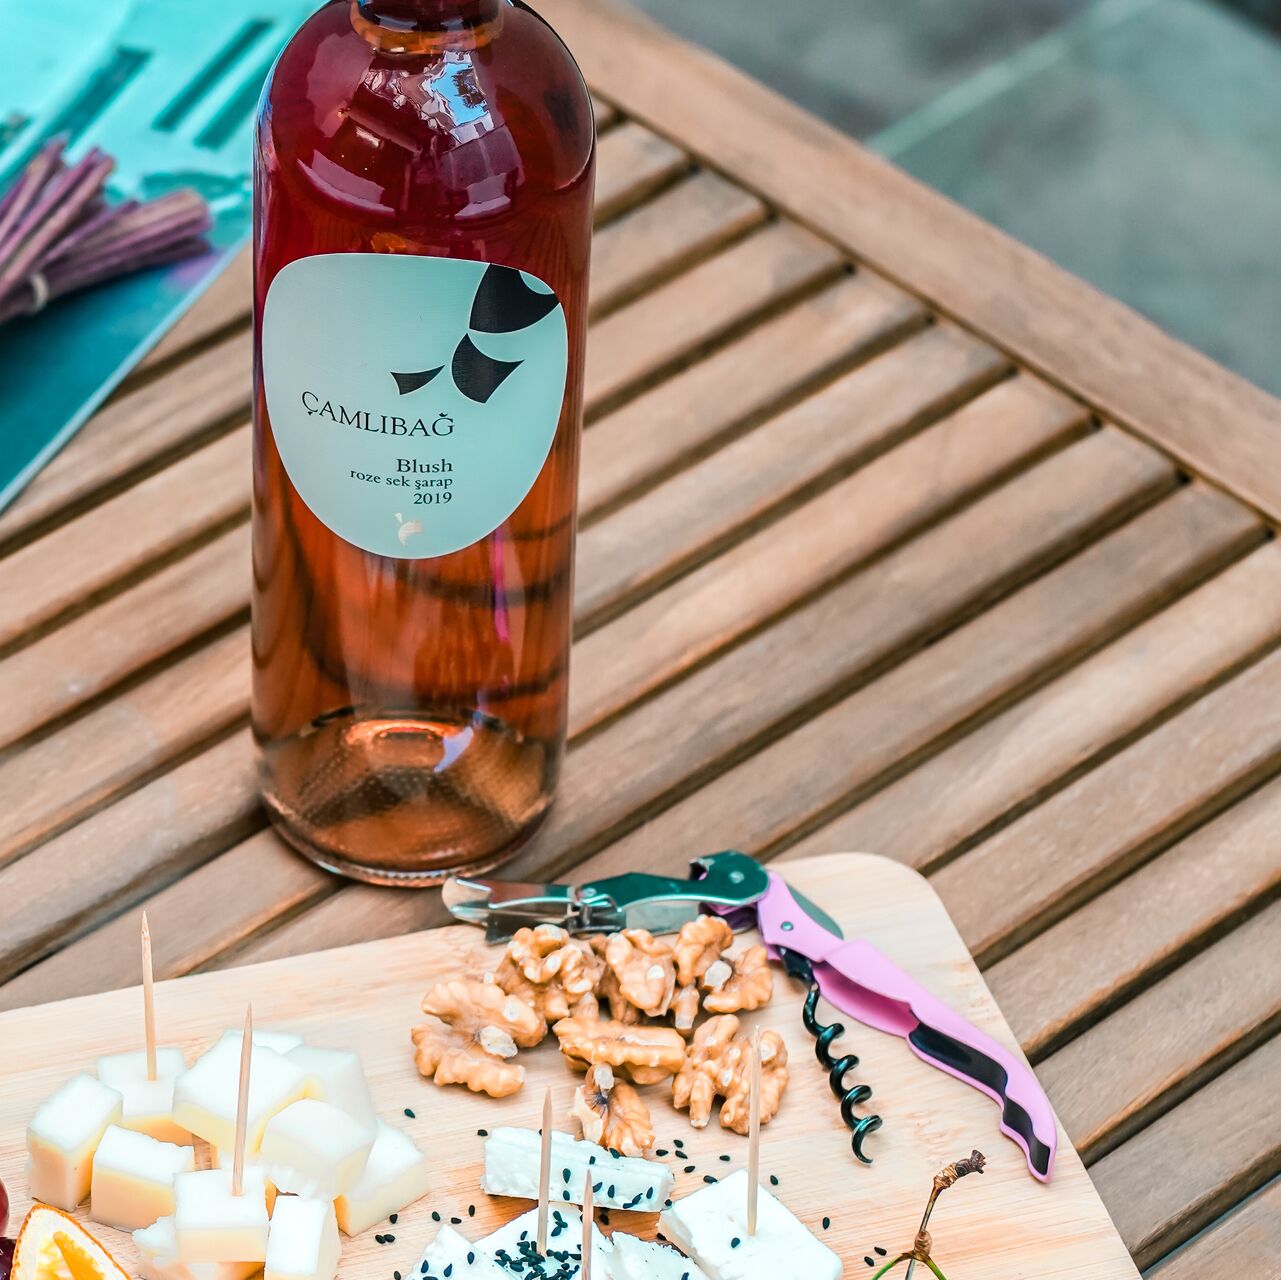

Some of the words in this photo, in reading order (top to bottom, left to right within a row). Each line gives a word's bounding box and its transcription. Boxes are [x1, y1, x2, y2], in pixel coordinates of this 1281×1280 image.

[301, 391, 455, 437] ÇAMLIBAĞ
[396, 458, 454, 474] Blush
[350, 470, 382, 485] roze
[385, 474, 411, 488] sek
[414, 475, 454, 491] şarap
[413, 491, 453, 506] 2019
